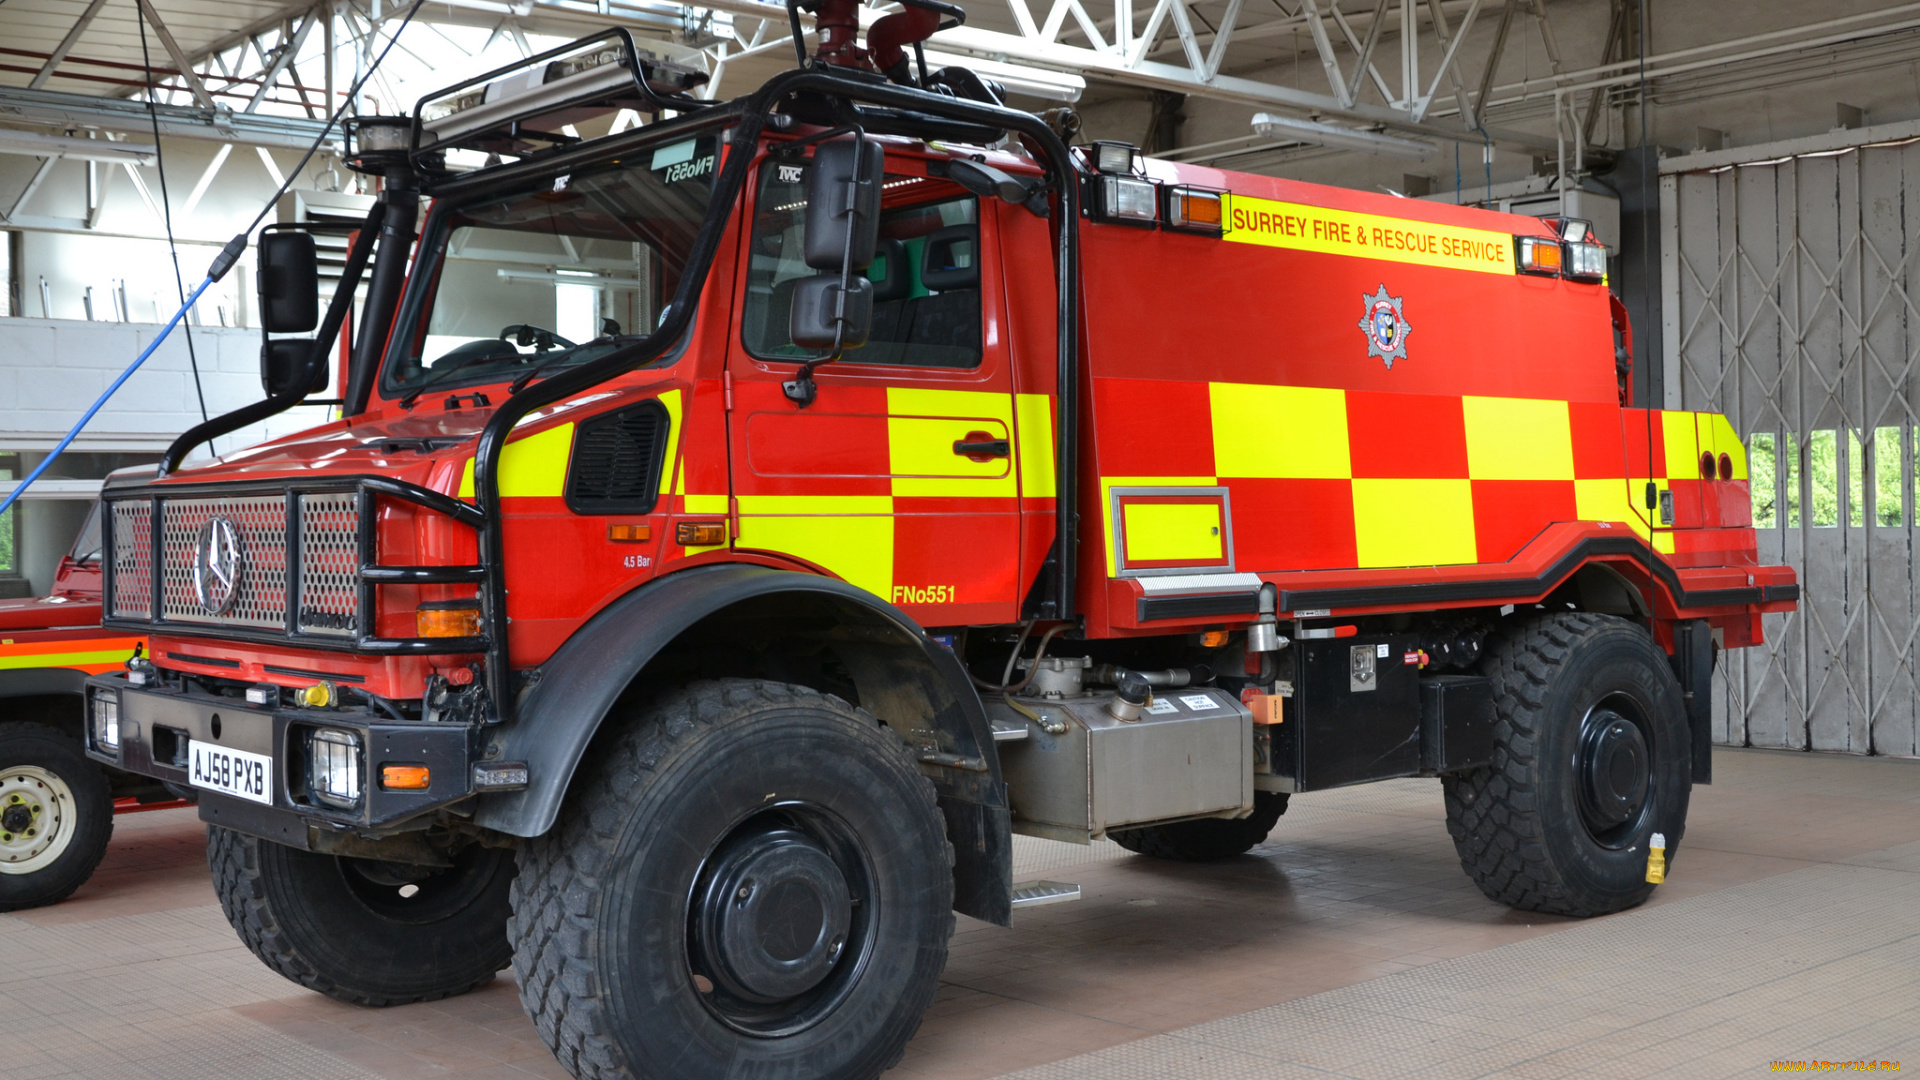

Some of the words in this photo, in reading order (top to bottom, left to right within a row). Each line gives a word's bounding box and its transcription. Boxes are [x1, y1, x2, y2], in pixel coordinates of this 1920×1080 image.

[1233, 208, 1307, 238] SURREY
[1313, 219, 1351, 243] FIRE
[1356, 226, 1368, 246] &
[1372, 227, 1438, 254] RESCUE
[1441, 237, 1505, 263] SERVICE
[624, 556, 635, 568] 4.5
[637, 555, 651, 567] Bar
[893, 585, 955, 604] FNo551
[194, 748, 230, 787] AJ58
[234, 757, 263, 795] PXB
